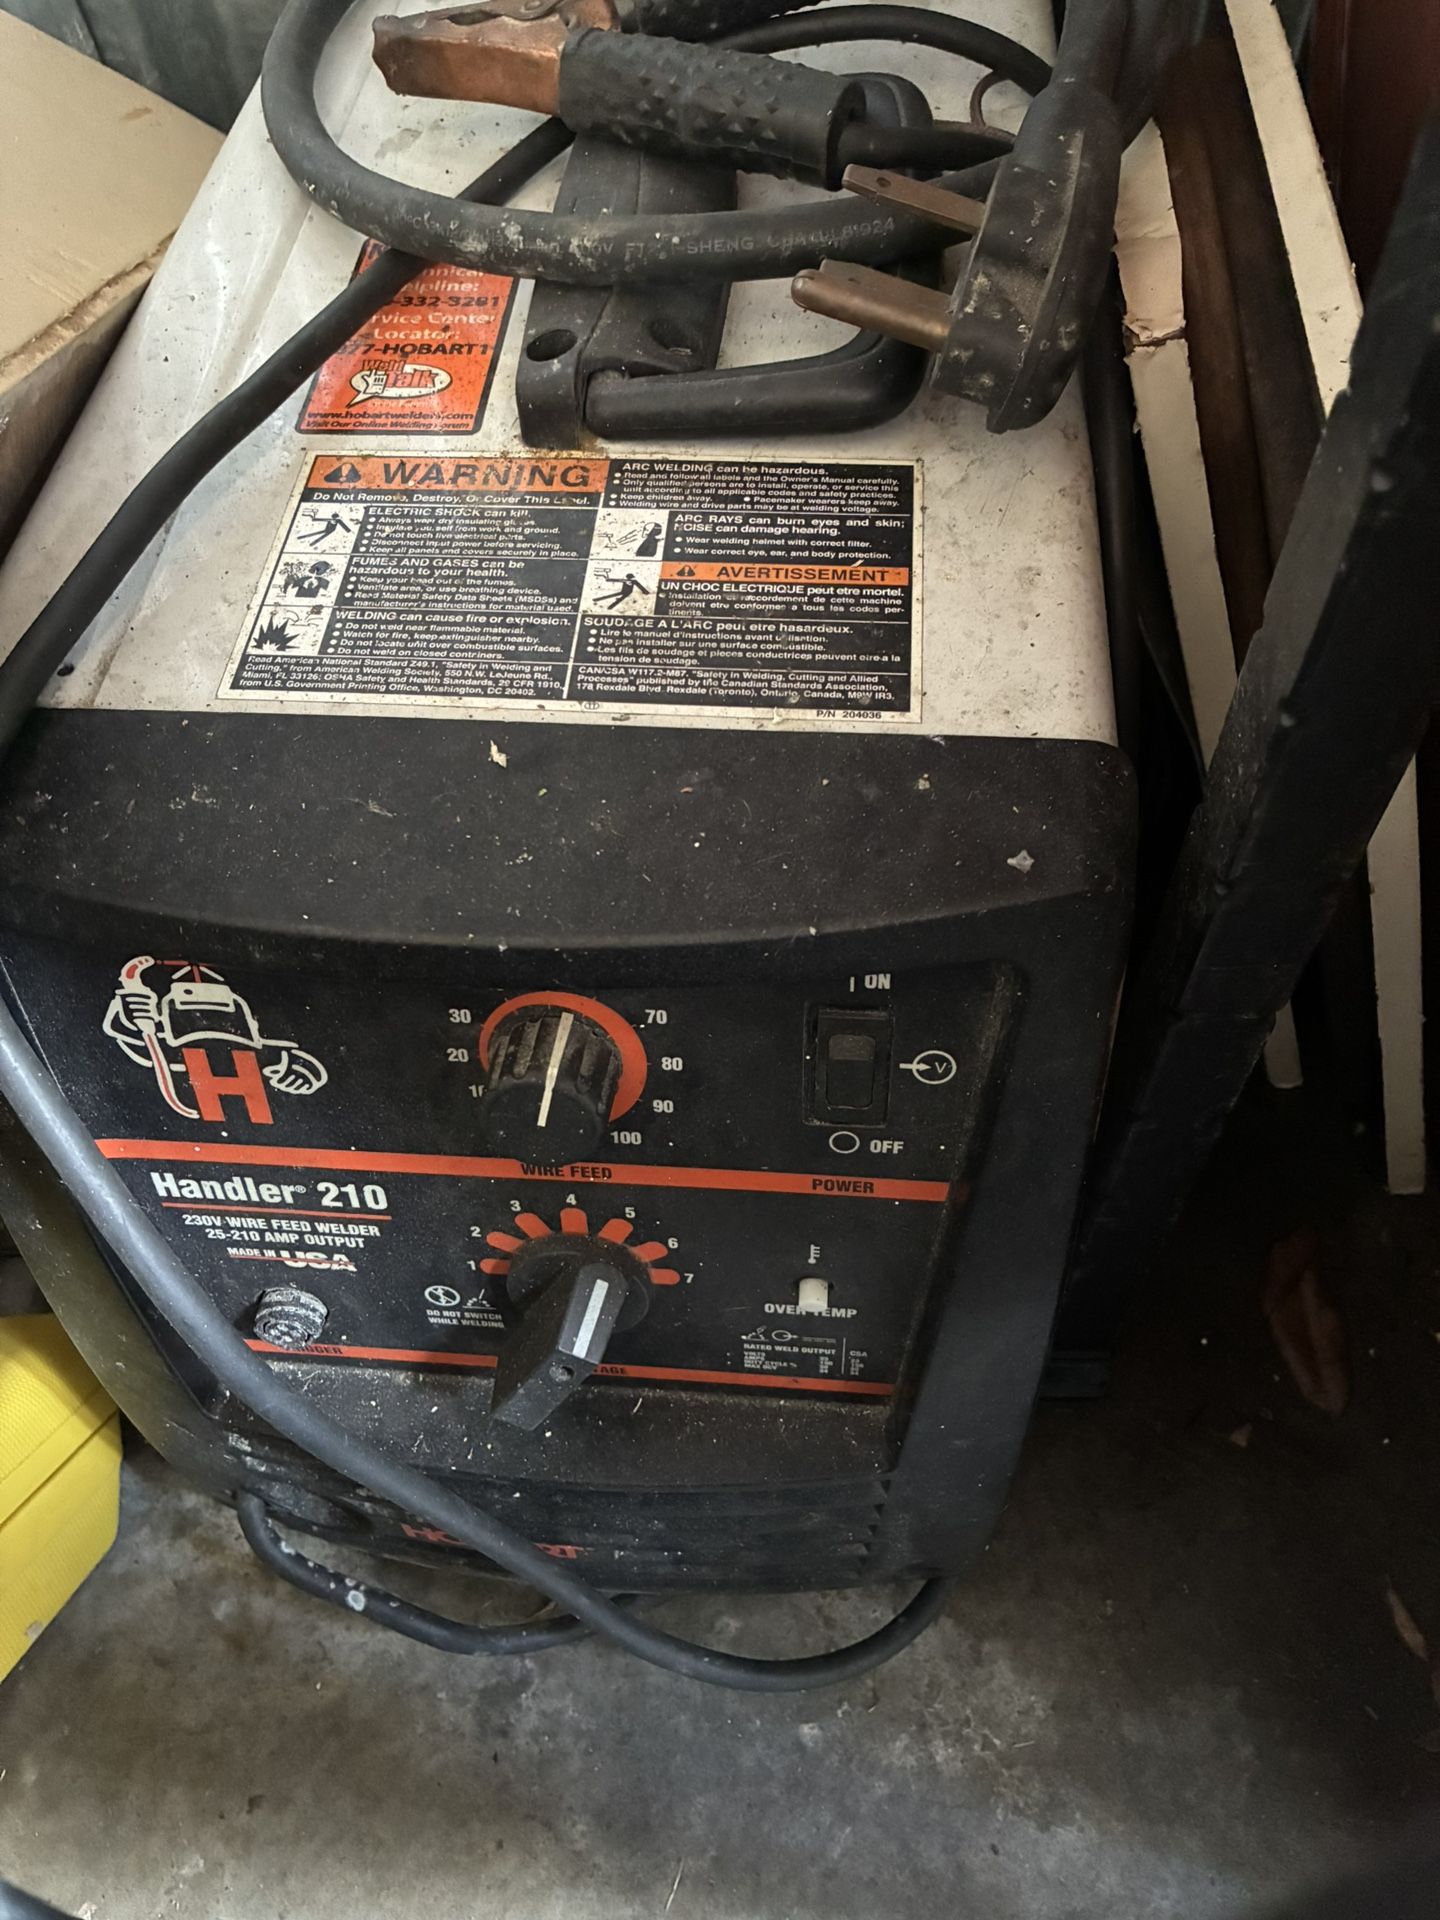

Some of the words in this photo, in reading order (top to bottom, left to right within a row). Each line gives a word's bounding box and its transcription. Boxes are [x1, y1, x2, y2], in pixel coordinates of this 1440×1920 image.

[374, 328, 461, 341] Locator:
[331, 420, 352, 428] Our
[352, 420, 389, 429] Online
[383, 462, 590, 488] WARNING
[622, 462, 650, 471] ARC
[653, 462, 713, 473] WELDING
[716, 465, 739, 473] can
[742, 464, 757, 474] be
[761, 465, 829, 476] hazardous.
[313, 492, 330, 501] Do
[333, 492, 354, 502] Not
[413, 493, 462, 504] Destroy,
[484, 495, 521, 504] Cover
[524, 495, 550, 504] This
[368, 507, 432, 516] ELECTRIC
[435, 508, 481, 517] SHOCK
[484, 509, 507, 518] can
[674, 514, 703, 524] ARC
[708, 515, 743, 525] RAYS
[749, 517, 771, 526] can
[777, 516, 806, 526] burn
[811, 518, 840, 529] eyes
[846, 518, 869, 528] and
[875, 518, 905, 530] skin;
[673, 523, 714, 533] NOISE
[715, 525, 738, 534] can
[740, 525, 790, 537] damage
[792, 526, 841, 538] hearing.
[685, 536, 710, 545] Wear
[711, 536, 750, 546] welding
[752, 538, 785, 546] helmet
[787, 538, 808, 547] with
[810, 539, 845, 548] correct
[847, 540, 873, 549] filter.
[684, 546, 709, 555] Wear
[711, 547, 746, 556] correct
[748, 550, 768, 559] eye,
[770, 550, 788, 559] ear,
[790, 549, 809, 558] and
[811, 549, 836, 560] body
[838, 551, 892, 561] protection.
[351, 556, 398, 566] FUMES
[400, 557, 430, 567] AND
[432, 558, 479, 569] GASES
[482, 560, 505, 569] can
[508, 559, 525, 569] be
[348, 566, 414, 576] hazardous
[417, 568, 430, 577] to
[433, 568, 462, 579] your
[466, 567, 508, 577] health.
[716, 565, 890, 582] AVERTISSEMENT
[660, 581, 680, 592] UN
[682, 582, 720, 593] CHOC
[722, 583, 805, 594] ELECTRIQUE
[807, 586, 835, 597] peut
[836, 587, 861, 596] etre
[862, 587, 905, 598] mortel.
[335, 610, 397, 621] WELDING
[399, 613, 422, 622] can
[425, 614, 464, 624] cause
[466, 613, 487, 624] fire
[489, 616, 504, 625] or
[505, 615, 571, 628] explosion.
[657, 618, 668, 629] A
[670, 619, 713, 630] L'ARC
[716, 621, 746, 632] peut
[749, 622, 776, 632] etre
[779, 623, 854, 635] hasardeux.
[239, 678, 262, 688] from
[264, 679, 284, 688] U.S.
[286, 680, 346, 690] Government
[347, 681, 386, 693] Printing
[388, 682, 420, 694] Office,
[423, 684, 485, 696] Washington,
[487, 686, 503, 696] DC
[504, 686, 537, 697] 20402.
[816, 709, 836, 719] P/N
[842, 710, 882, 720] 204036
[864, 973, 891, 990] ON
[448, 1008, 472, 1025] 30
[644, 1009, 669, 1026] 70
[446, 1047, 470, 1063] 20
[661, 1056, 684, 1073] 80
[182, 1046, 273, 1124] H
[652, 1099, 675, 1115] 90
[610, 1130, 642, 1146] 100
[869, 1138, 905, 1155] OFF
[520, 1162, 565, 1178] WIRE
[569, 1164, 613, 1180] FEED
[811, 1178, 875, 1194] POWER
[317, 1180, 389, 1211] 210
[565, 1192, 578, 1206] 4
[509, 1199, 521, 1213] 3
[624, 1206, 636, 1220] 5
[182, 1213, 222, 1228] 230V
[224, 1216, 269, 1231] WIRE
[271, 1218, 312, 1233] FEED
[314, 1221, 381, 1238] WELDER
[469, 1225, 482, 1239] 2
[204, 1228, 261, 1243] 25-210
[264, 1230, 300, 1245] AMP
[304, 1233, 365, 1249] OUTPUT
[667, 1236, 679, 1250] 6
[226, 1246, 261, 1258] MADE
[262, 1248, 277, 1259] IN
[278, 1250, 358, 1273] USA
[467, 1260, 477, 1272] 1
[684, 1273, 695, 1285] 7
[426, 1308, 443, 1318] DO
[444, 1309, 462, 1319] NOT
[464, 1311, 503, 1321] SWITCH
[428, 1316, 460, 1326] WHILE
[460, 1318, 506, 1330] WELDING
[743, 1343, 773, 1352] RATED
[774, 1345, 800, 1353] WELD
[801, 1346, 837, 1355] OUTPUT
